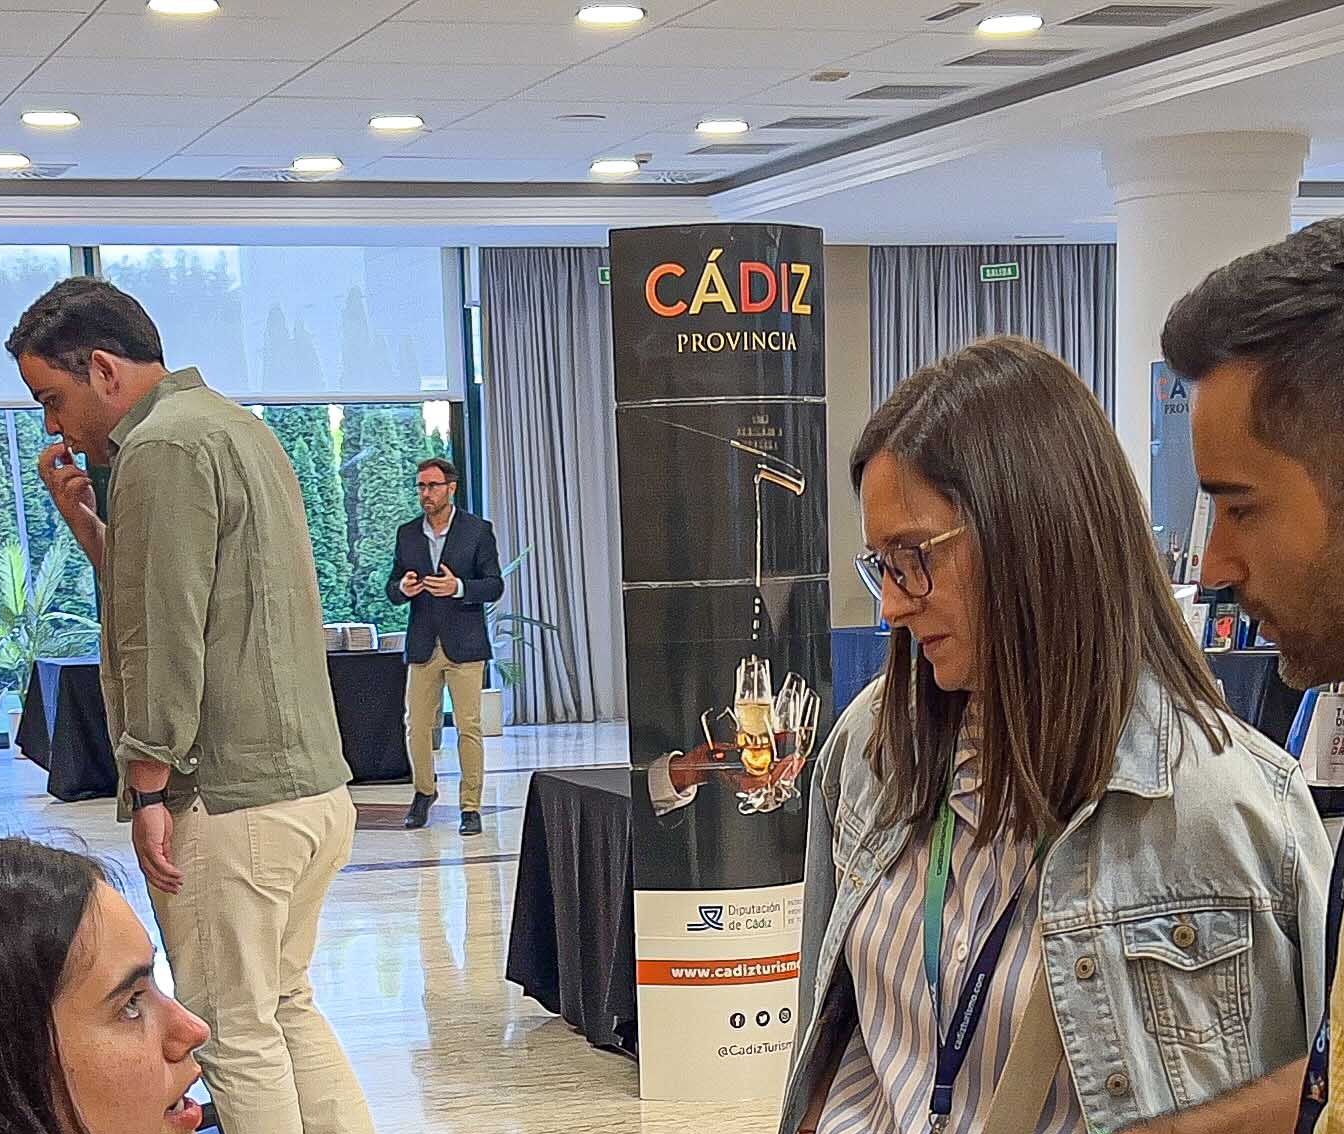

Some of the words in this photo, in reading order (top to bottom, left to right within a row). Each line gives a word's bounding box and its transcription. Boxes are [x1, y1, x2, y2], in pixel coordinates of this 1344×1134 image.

[645, 248, 813, 317] CÁDIZ
[677, 331, 798, 353] PROVINCIA
[728, 902, 781, 918] Diputación
[728, 921, 741, 930] de
[745, 918, 772, 930] Cádiz
